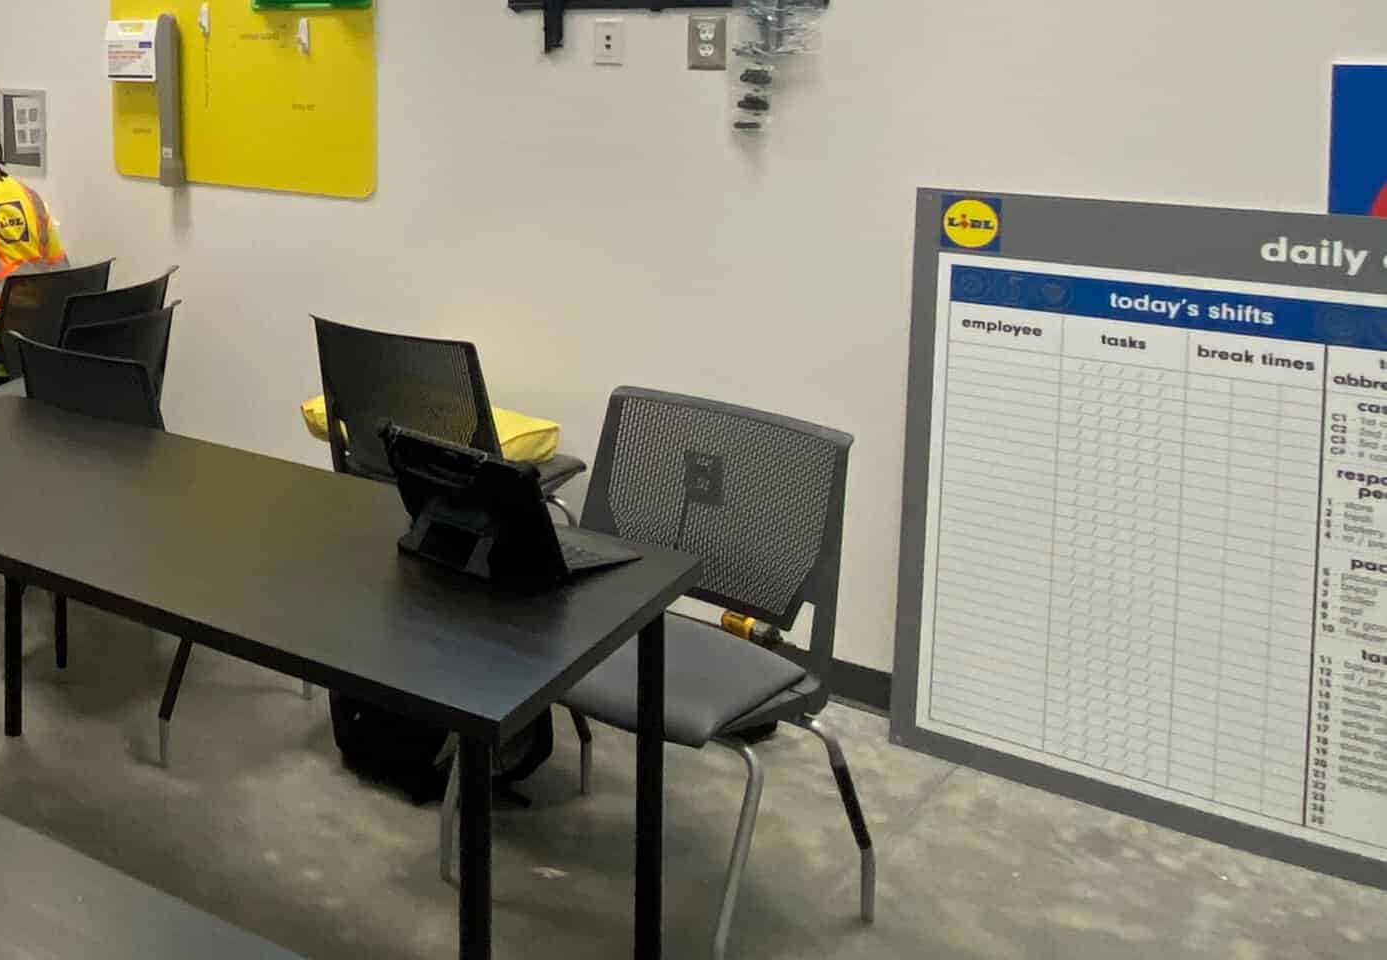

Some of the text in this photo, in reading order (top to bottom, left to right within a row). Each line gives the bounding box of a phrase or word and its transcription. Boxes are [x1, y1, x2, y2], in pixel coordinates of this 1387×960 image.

[1260, 236, 1368, 276] daily
[1109, 293, 1274, 325] today's shifts
[961, 317, 1043, 337] employee
[1101, 333, 1147, 351] tasks
[1197, 344, 1316, 372] break times
